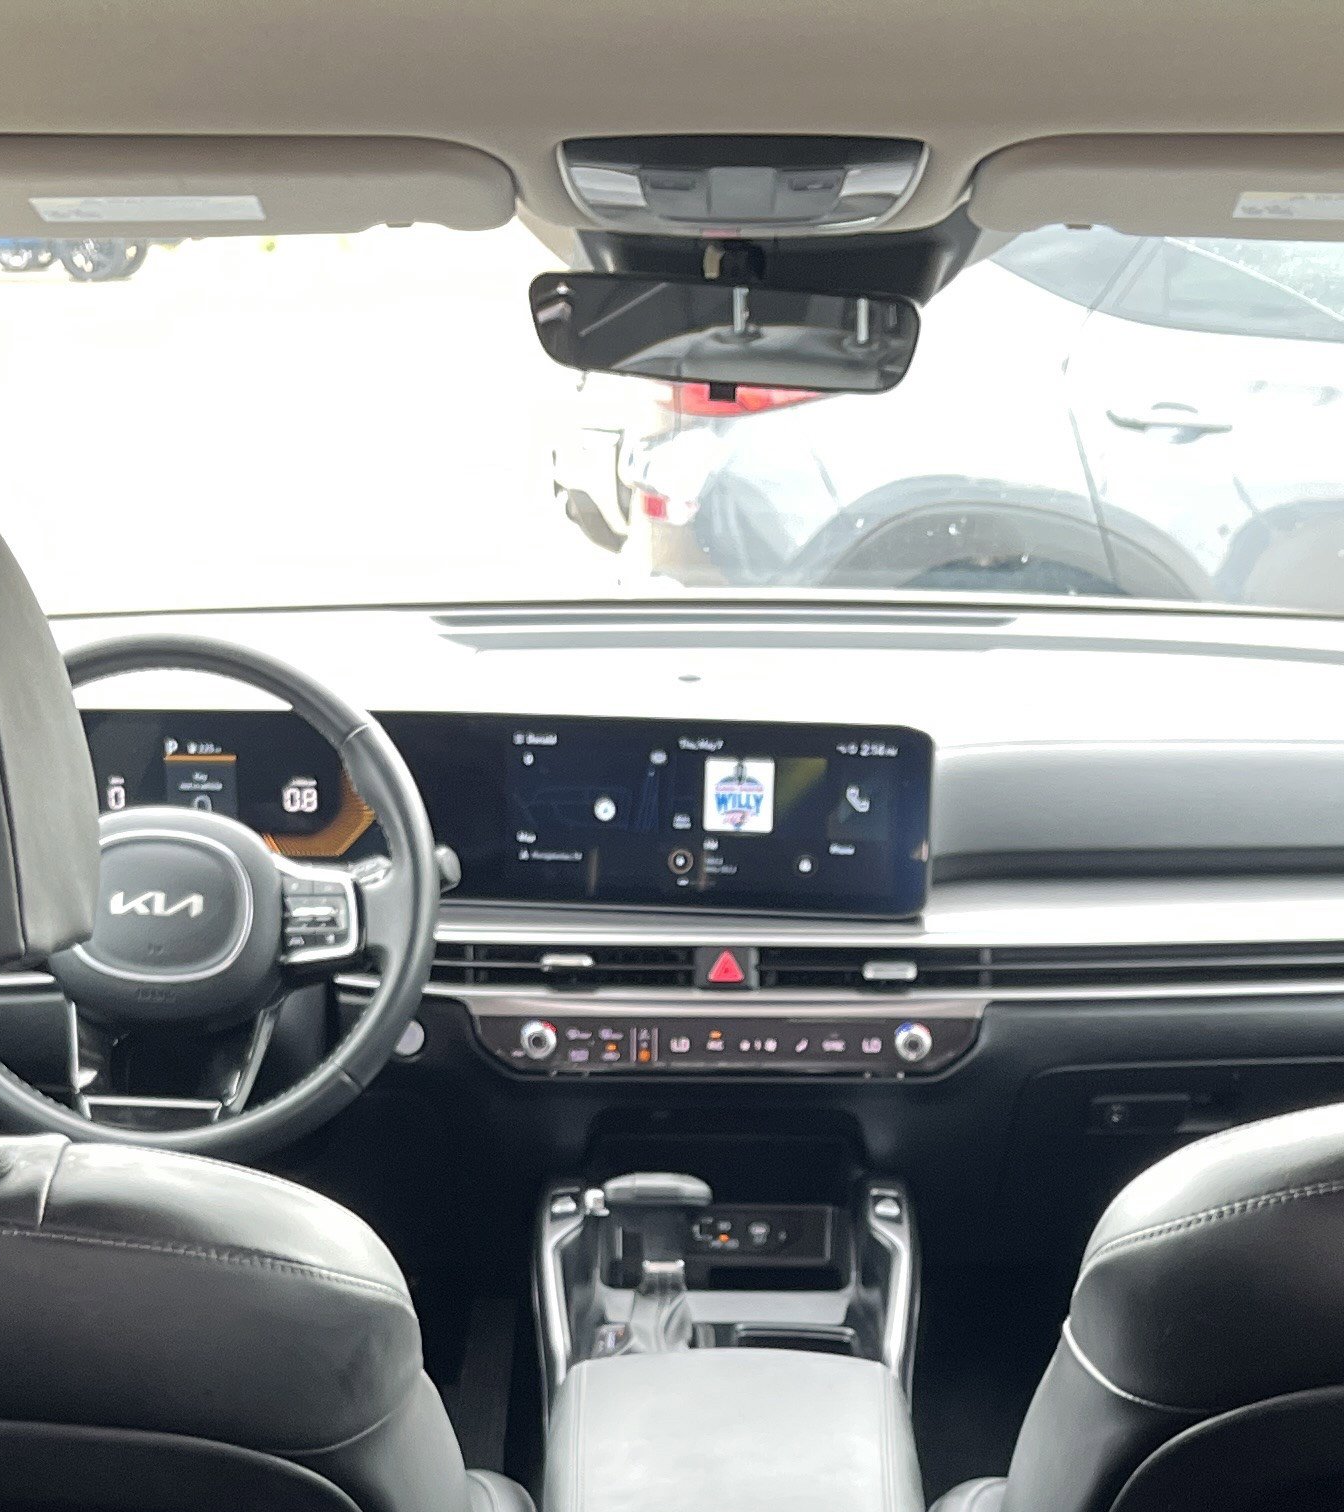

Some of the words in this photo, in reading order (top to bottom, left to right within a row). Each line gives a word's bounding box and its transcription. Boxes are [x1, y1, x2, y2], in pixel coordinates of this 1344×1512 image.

[107, 786, 126, 811] 0
[714, 792, 764, 817] WILLY
[110, 891, 204, 918] KIA
